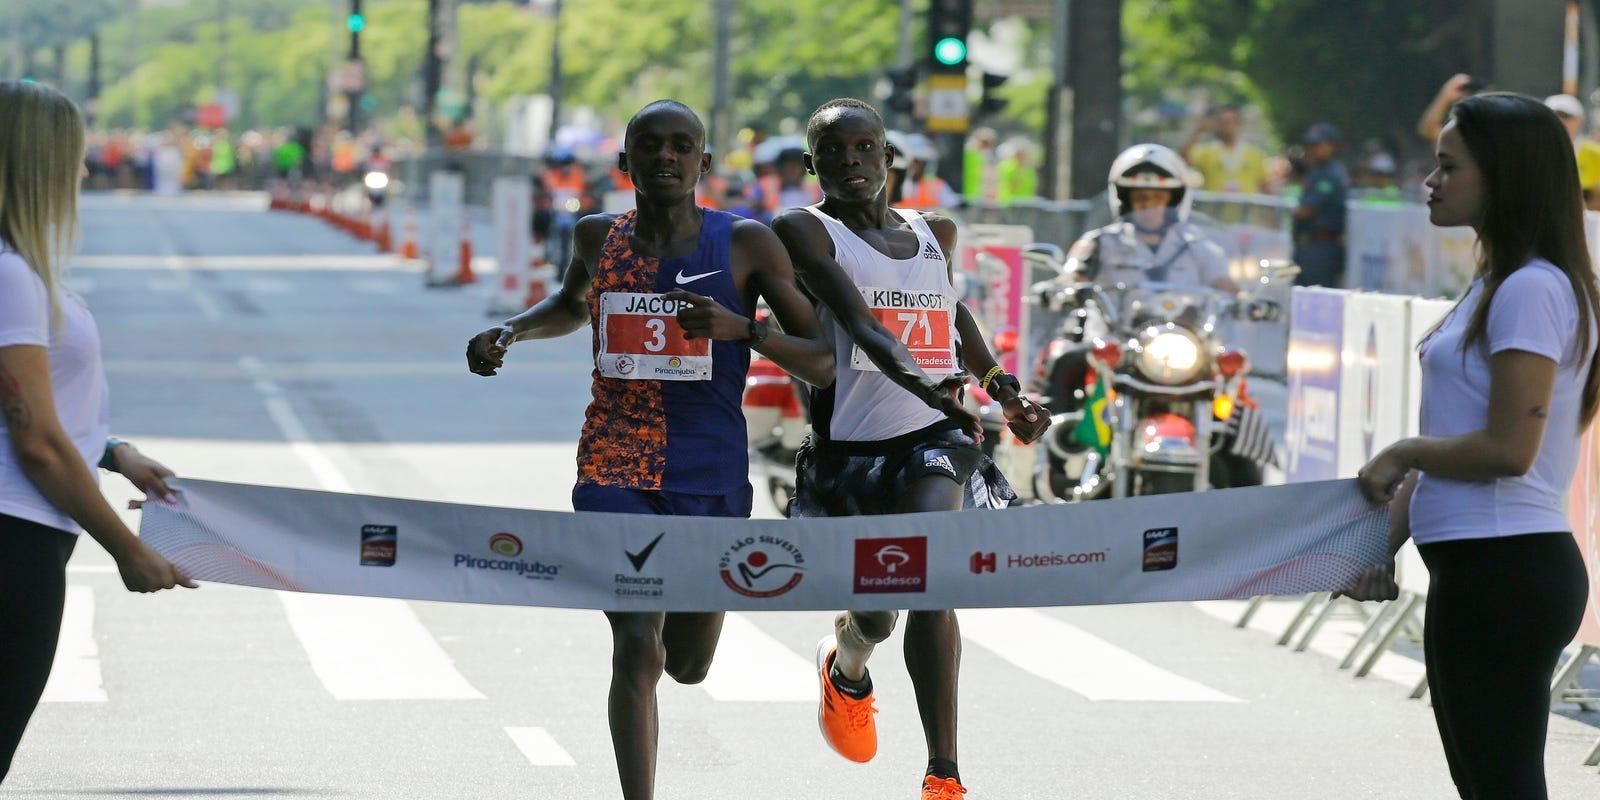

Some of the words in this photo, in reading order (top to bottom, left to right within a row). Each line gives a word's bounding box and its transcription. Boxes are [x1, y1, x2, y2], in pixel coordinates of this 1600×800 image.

[644, 318, 666, 352] 3
[897, 313, 933, 345] 71
[916, 356, 952, 366] bradesco
[654, 366, 695, 377] Piracanjuba
[730, 537, 755, 553] SÃO
[758, 535, 805, 564] SILVESTRE
[453, 553, 559, 575] Piracanjuba
[615, 573, 664, 585] Rexona
[860, 576, 921, 586] bradesco
